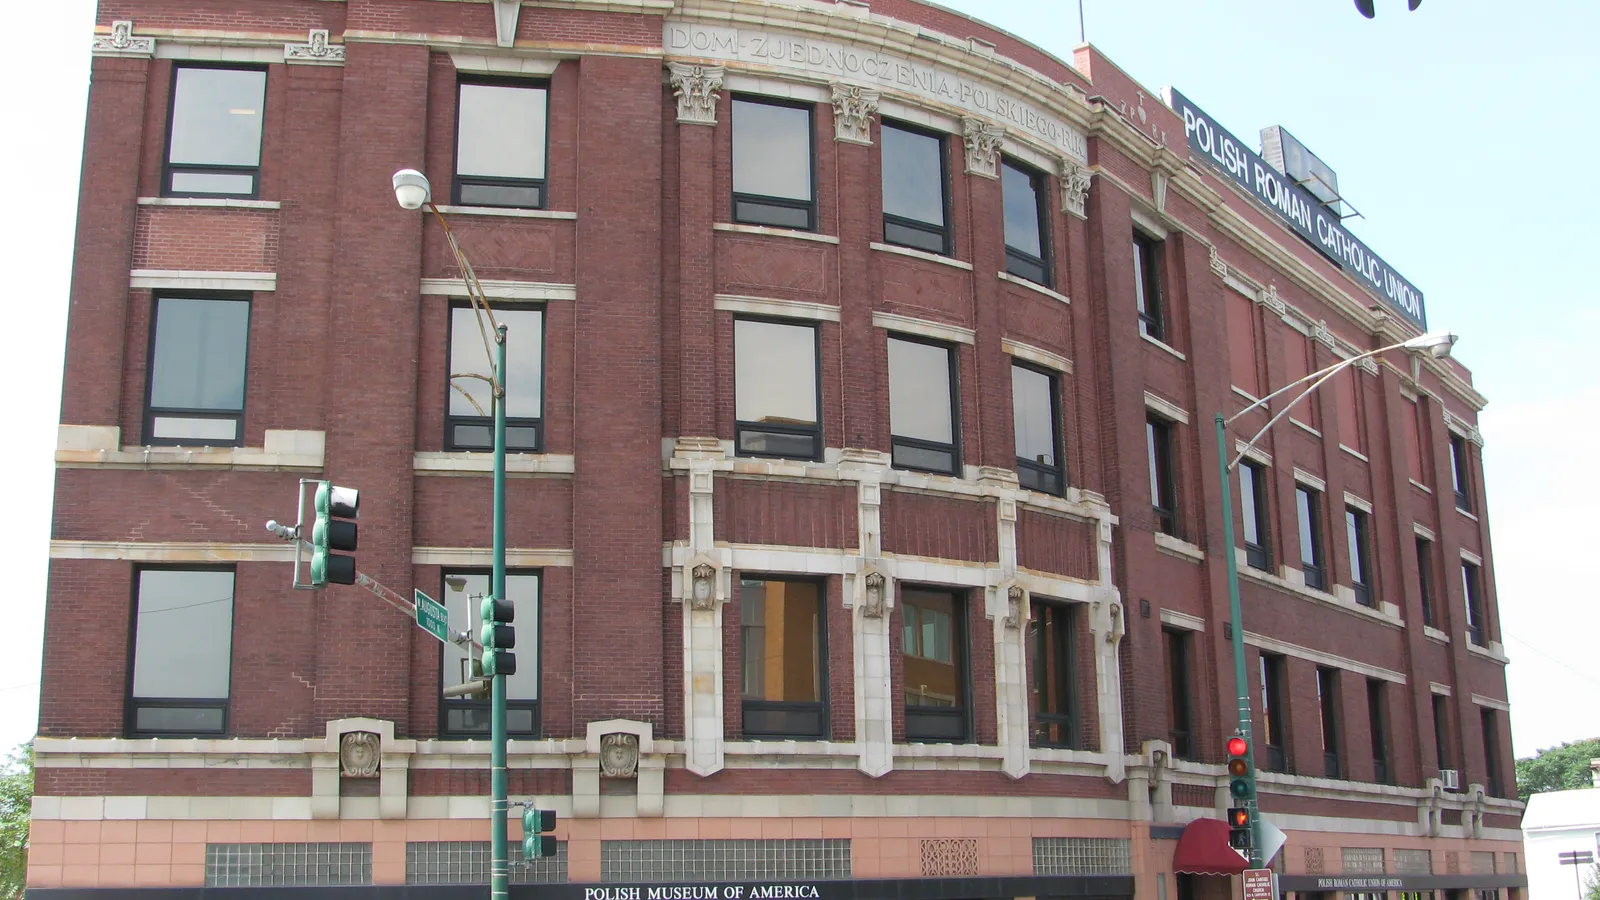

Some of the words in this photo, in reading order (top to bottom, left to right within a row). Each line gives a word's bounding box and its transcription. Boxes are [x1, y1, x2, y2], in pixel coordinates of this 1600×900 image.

[670, 27, 738, 55] DOM
[1183, 105, 1249, 184] POLISH
[1254, 162, 1312, 234] ROMAN
[1316, 214, 1381, 288] CATHOLIC
[1383, 268, 1421, 320] UNION
[584, 887, 641, 900] POLISH
[647, 886, 718, 900] MUSEUM
[723, 886, 744, 899] OF
[749, 885, 820, 899] AMERICA
[1318, 878, 1333, 888] POLISH
[1333, 878, 1348, 888] ROMAN
[1349, 878, 1368, 888] CATHOLIC
[1368, 878, 1381, 888] UNION
[1381, 878, 1386, 887] OF
[1386, 878, 1403, 887] AMERICA
